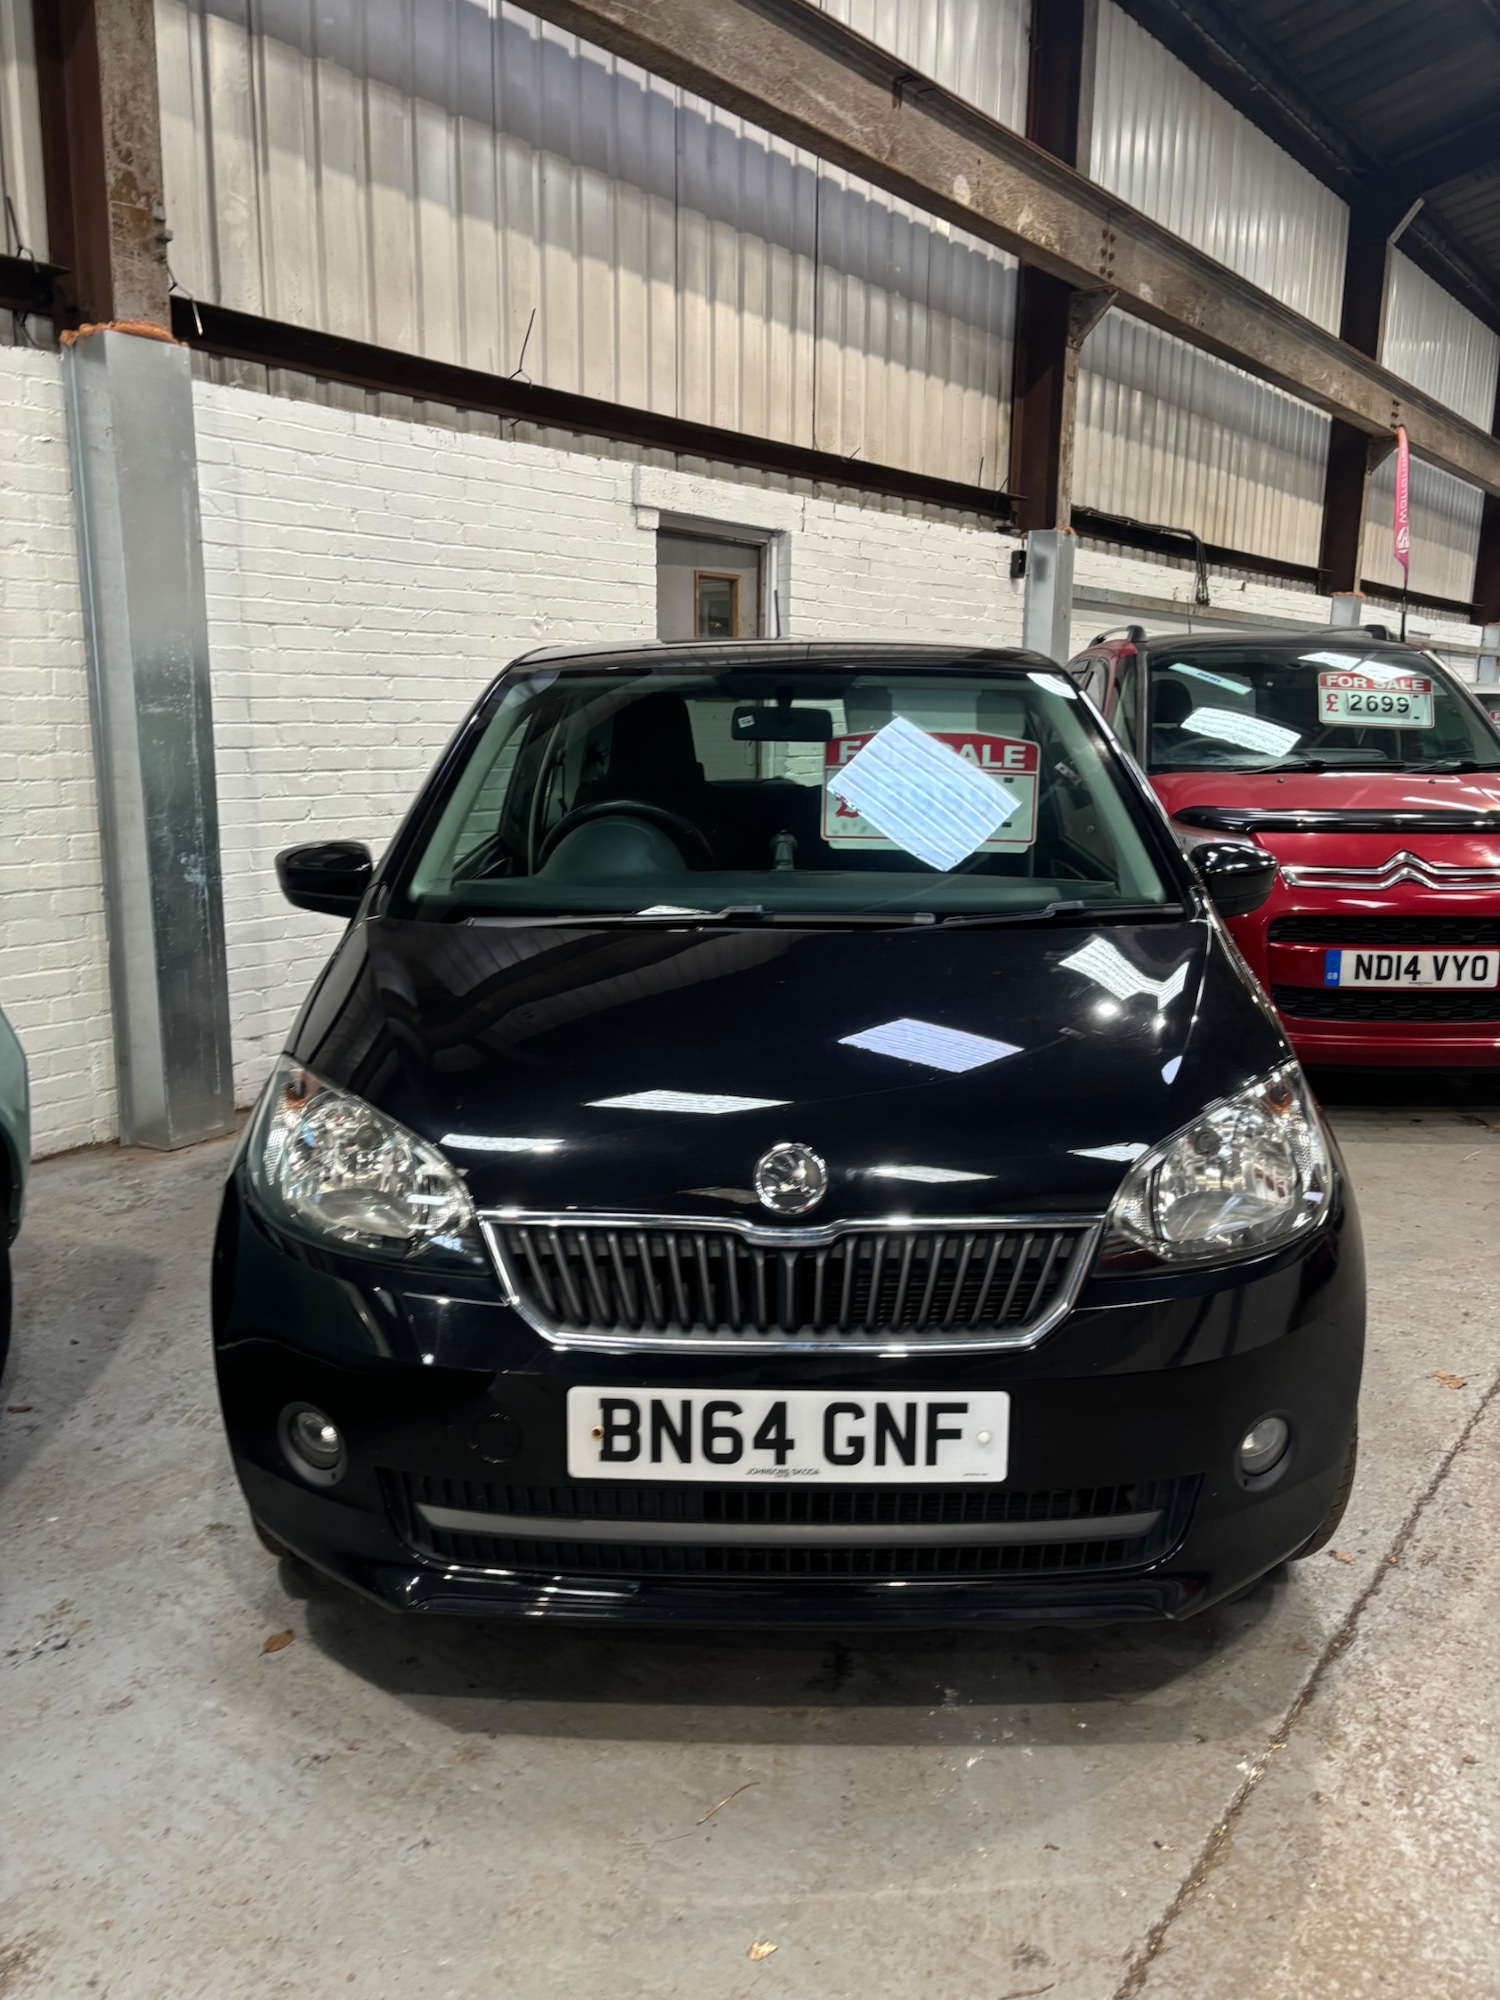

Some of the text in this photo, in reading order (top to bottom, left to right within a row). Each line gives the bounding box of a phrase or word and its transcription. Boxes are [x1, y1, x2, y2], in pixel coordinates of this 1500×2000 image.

[1326, 675, 1424, 691] FOR SALE
[1326, 693, 1409, 713] £ 2699
[947, 741, 1026, 769] ALE
[1354, 954, 1488, 981] ND14 VYO
[598, 1397, 969, 1467] BN64 GNF
